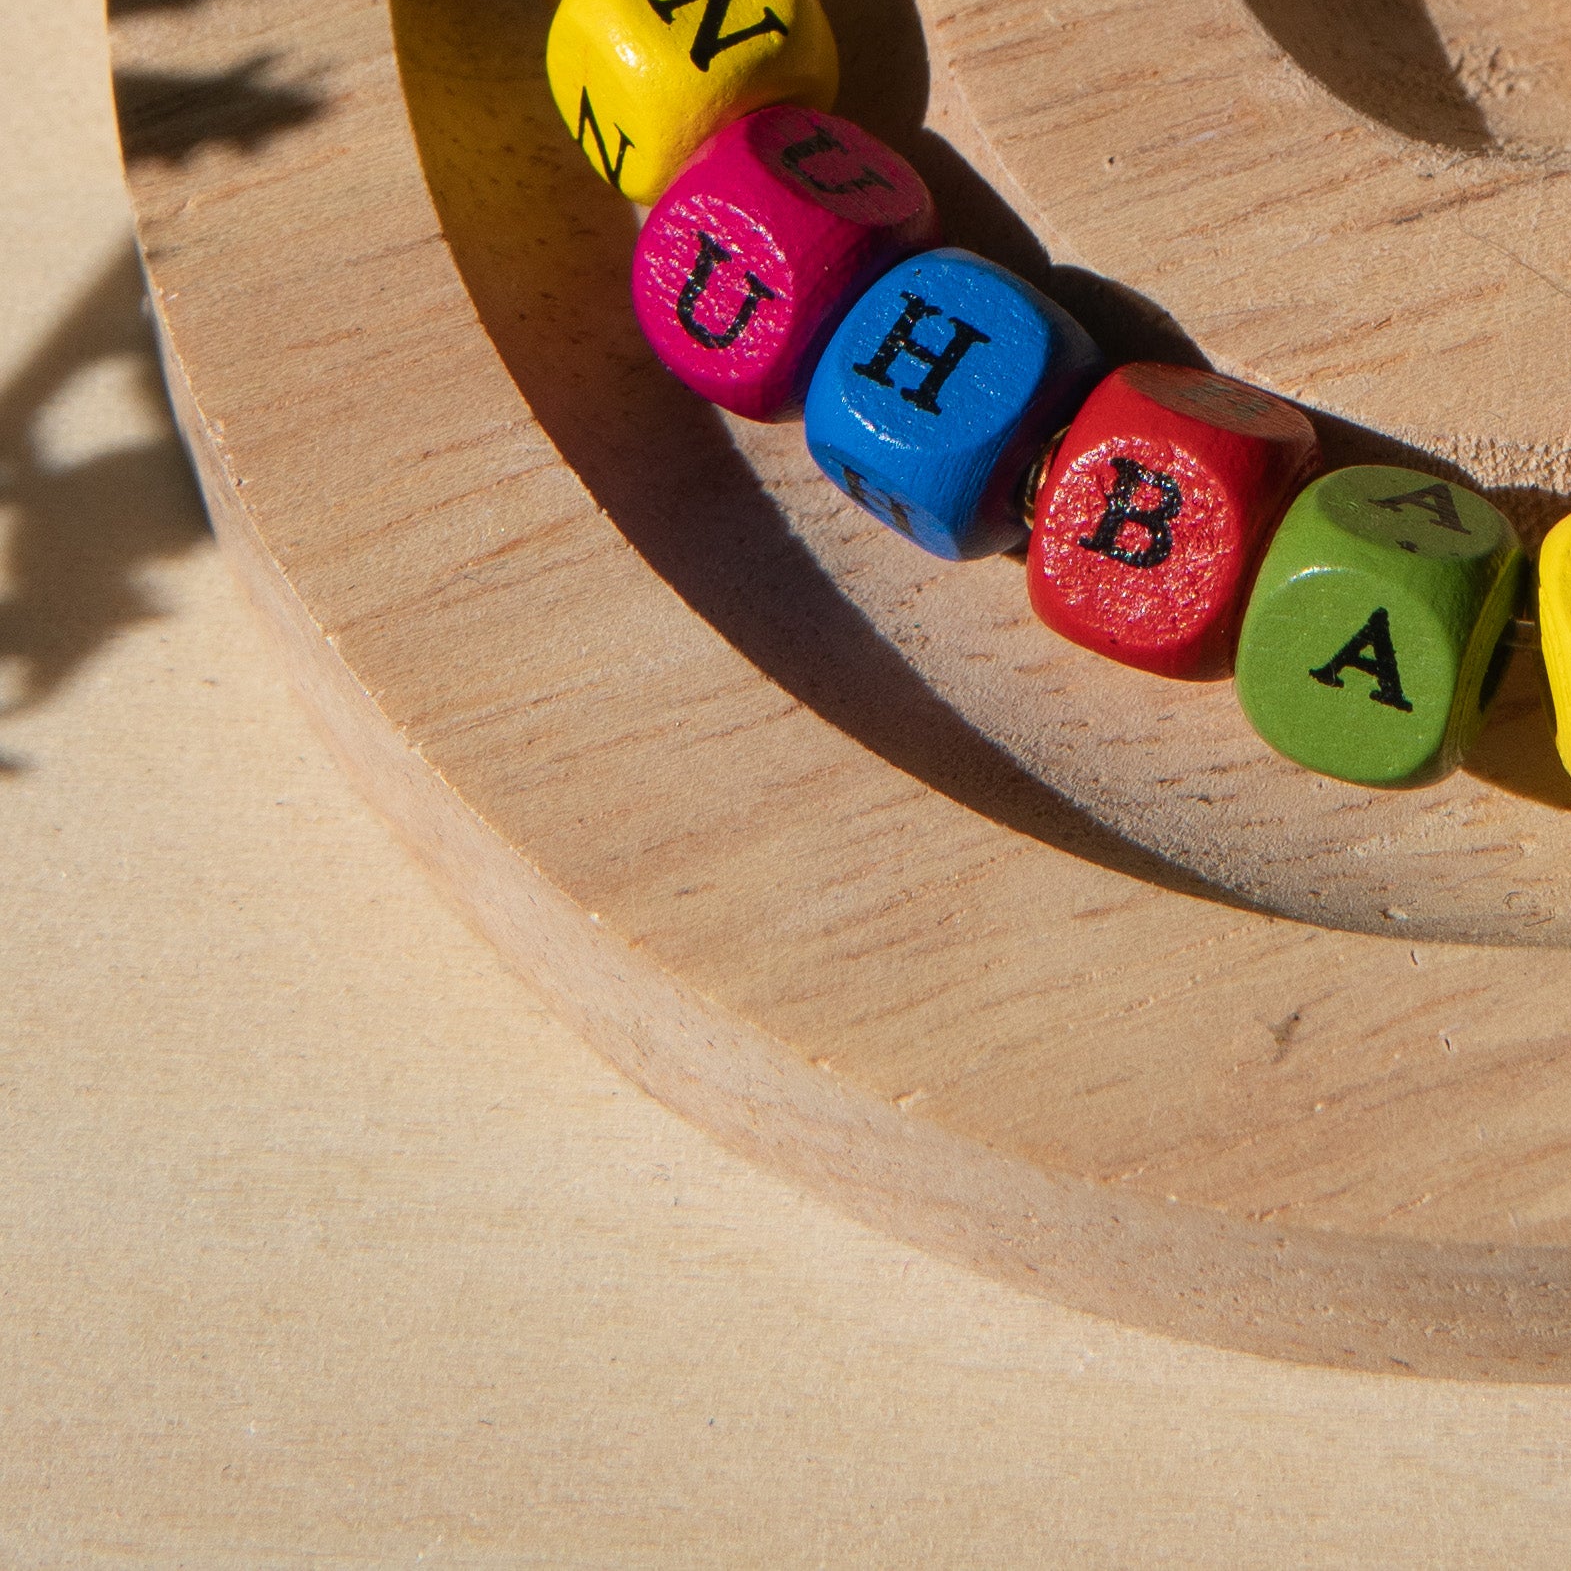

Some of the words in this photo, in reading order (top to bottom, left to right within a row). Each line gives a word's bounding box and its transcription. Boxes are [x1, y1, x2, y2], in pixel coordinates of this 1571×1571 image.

[676, 228, 775, 350] U
[851, 290, 991, 416] H
[1078, 456, 1182, 569] B
[1366, 482, 1472, 536] A
[1308, 606, 1414, 713] A
